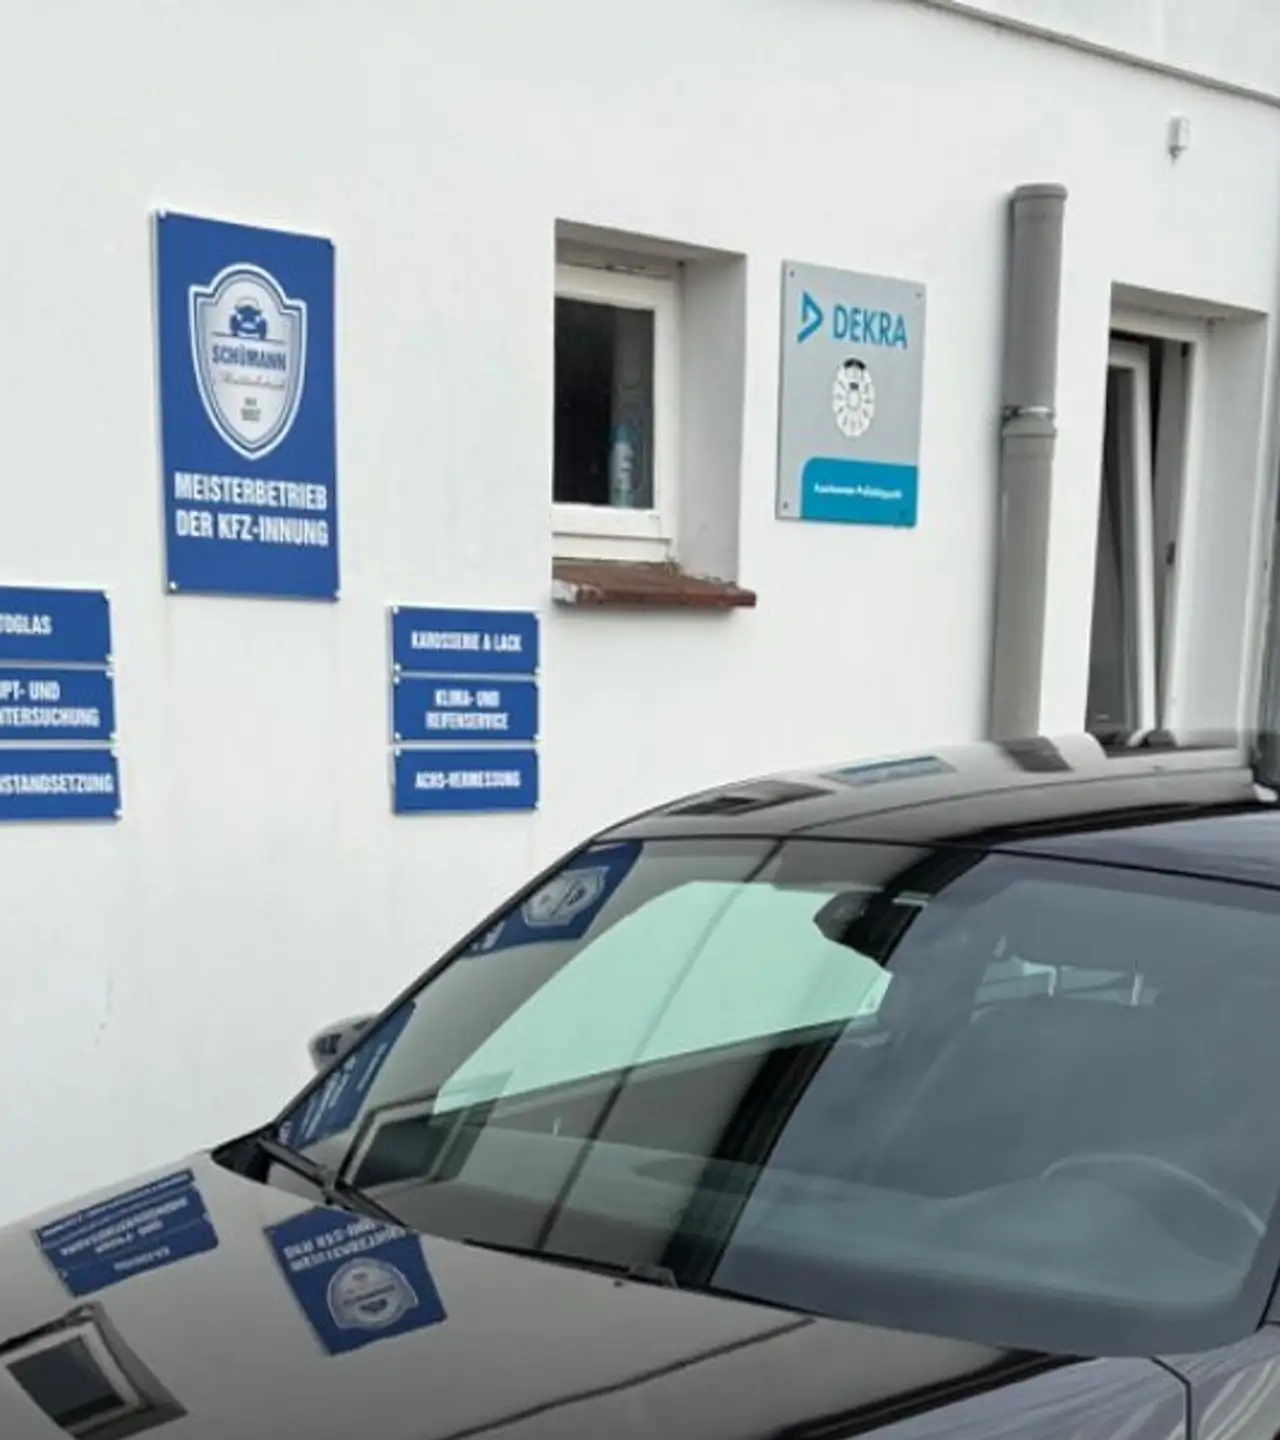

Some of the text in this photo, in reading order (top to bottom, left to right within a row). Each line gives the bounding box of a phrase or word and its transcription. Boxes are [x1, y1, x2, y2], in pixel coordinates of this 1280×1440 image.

[833, 304, 907, 349] DEKRA
[213, 344, 286, 371] SCHÜMANN
[174, 471, 327, 510] MEISTERBETRIEB
[176, 509, 328, 546] DER KFZ-INNUNG
[29, 681, 60, 700] UND
